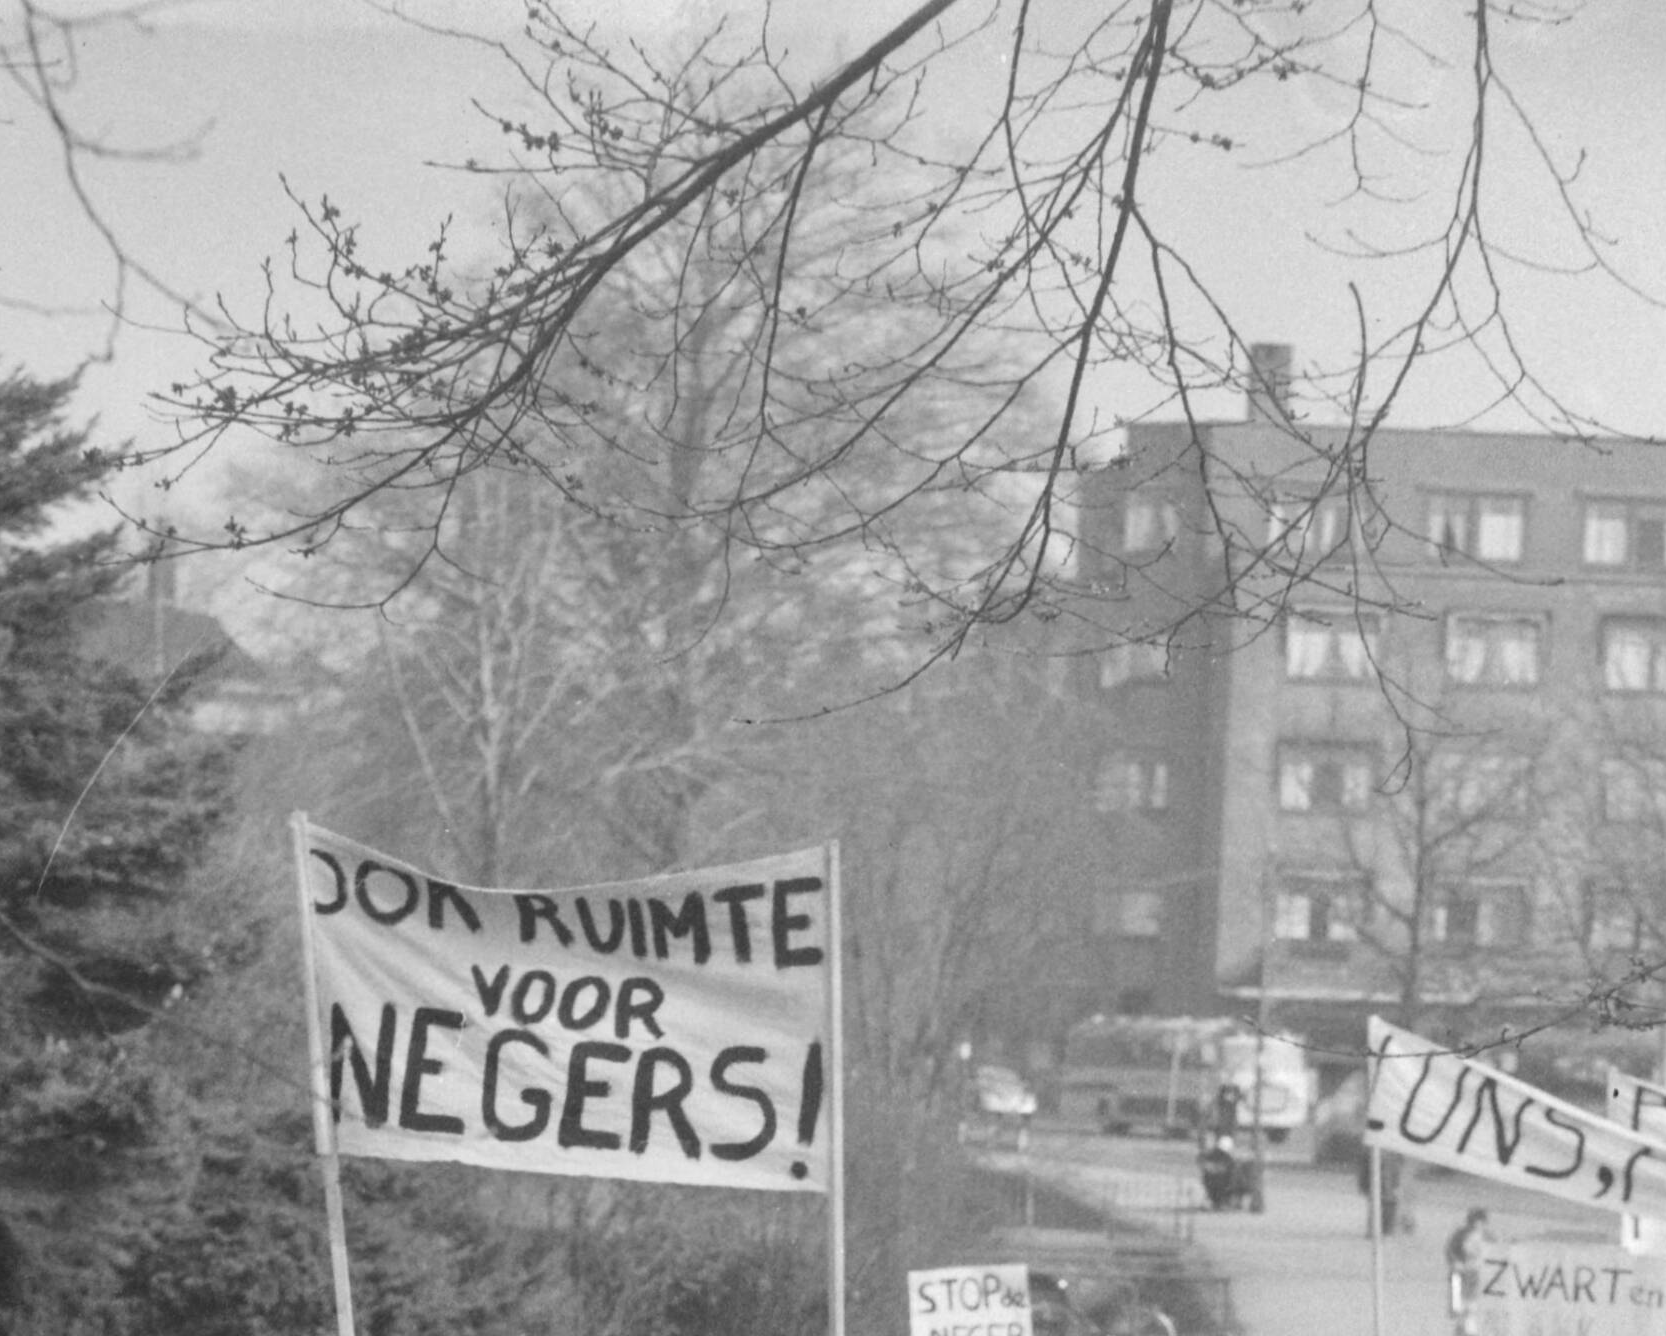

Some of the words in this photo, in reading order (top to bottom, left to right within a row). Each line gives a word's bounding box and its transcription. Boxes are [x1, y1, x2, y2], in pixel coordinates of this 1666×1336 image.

[513, 876, 824, 969] RUIMTE
[471, 963, 666, 1039] VOOR
[333, 1002, 824, 1181] NEGERS!
[917, 1274, 1001, 1313] STOP
[1483, 1259, 1634, 1304] ZWART
